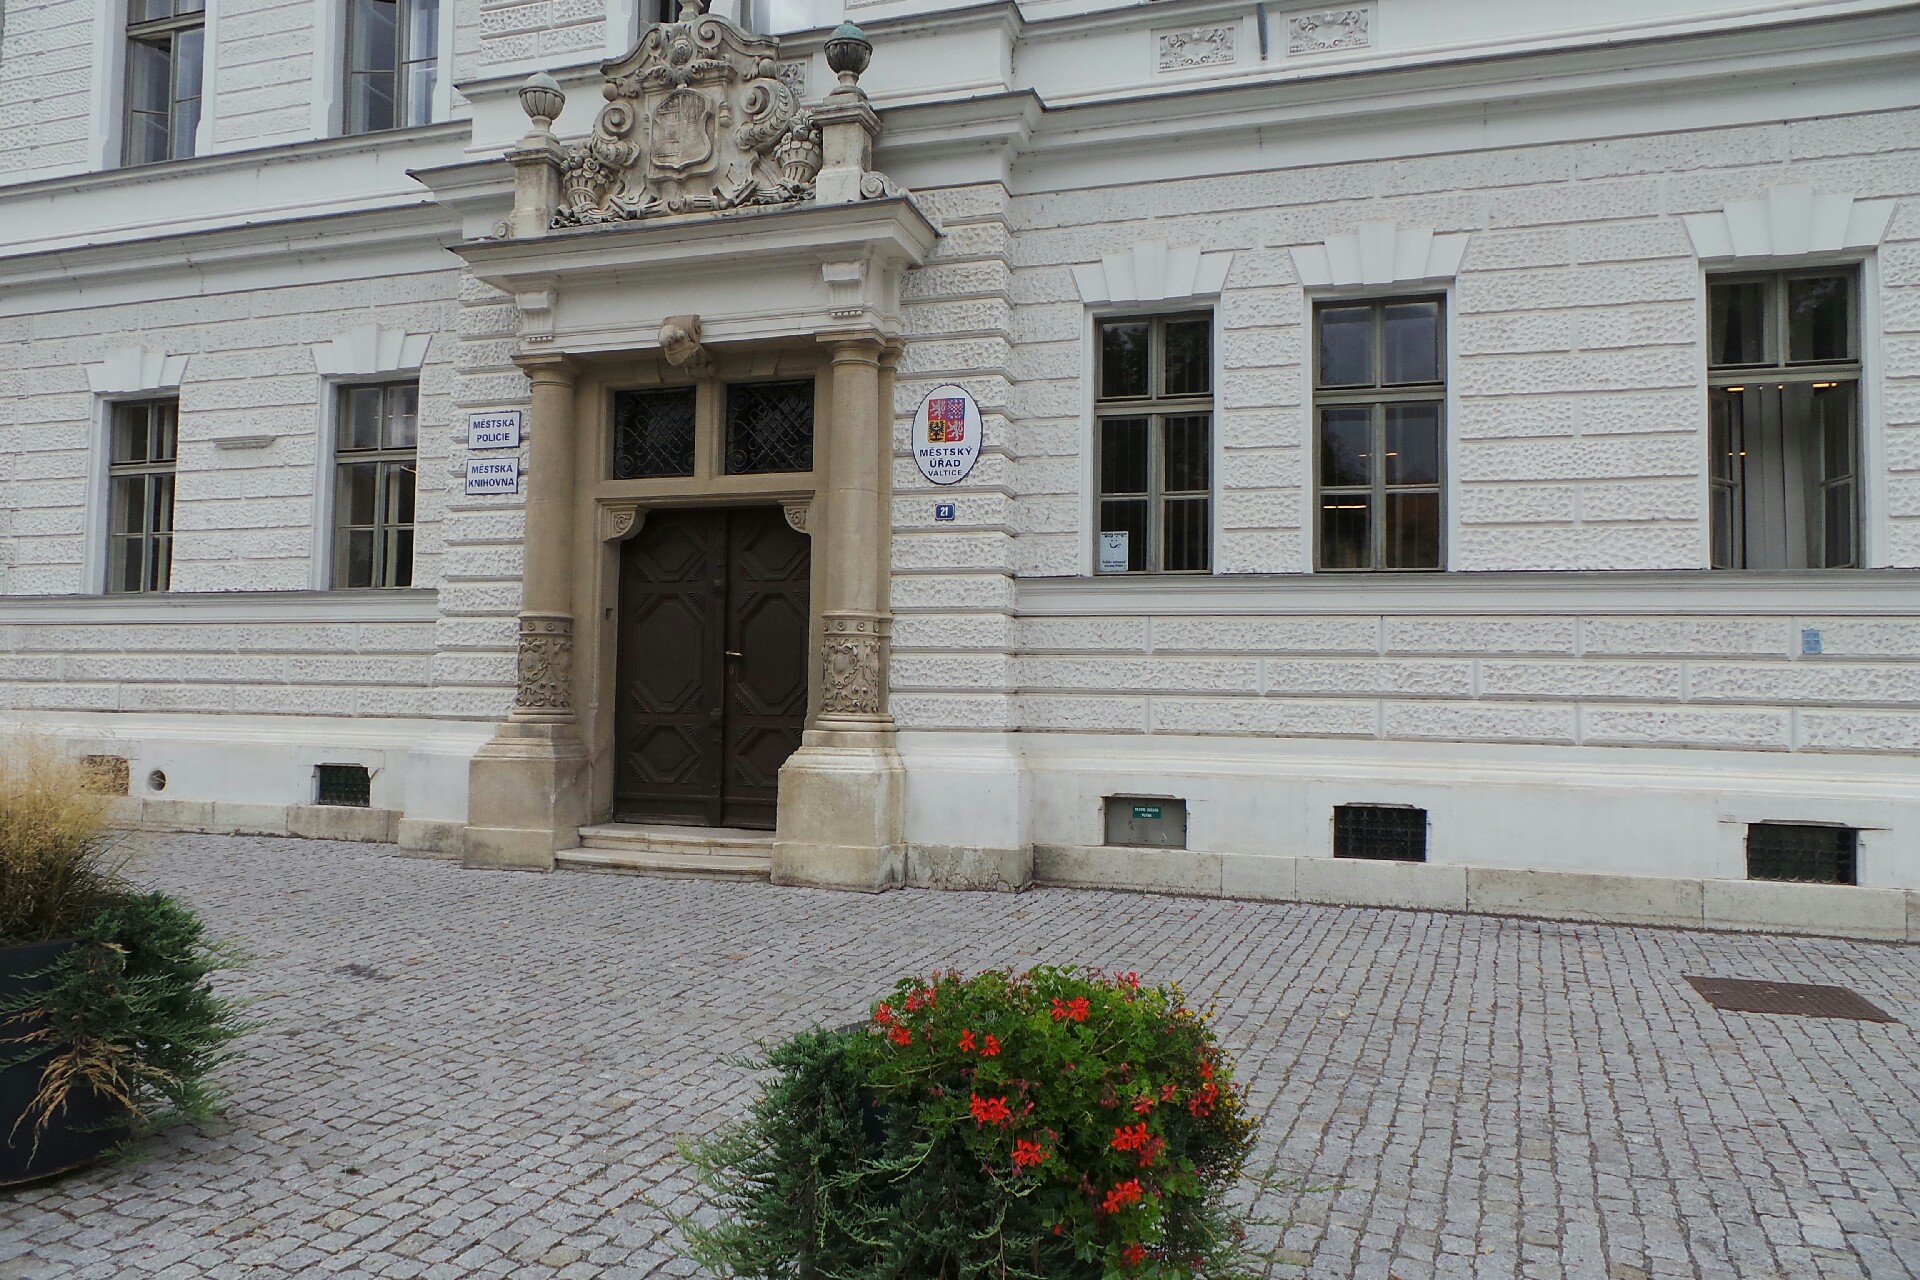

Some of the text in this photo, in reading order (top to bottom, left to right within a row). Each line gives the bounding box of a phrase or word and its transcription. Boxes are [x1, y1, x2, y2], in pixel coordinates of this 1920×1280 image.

[473, 417, 515, 429] MĚSTSKÁ
[476, 433, 510, 442] POLICIE
[919, 446, 973, 457] MĚSTSKÝ
[471, 463, 513, 474] MĚSTSKÁ
[929, 458, 961, 468] ÚŘAD
[468, 478, 515, 488] KNIHOVNA
[940, 506, 949, 517] 21
